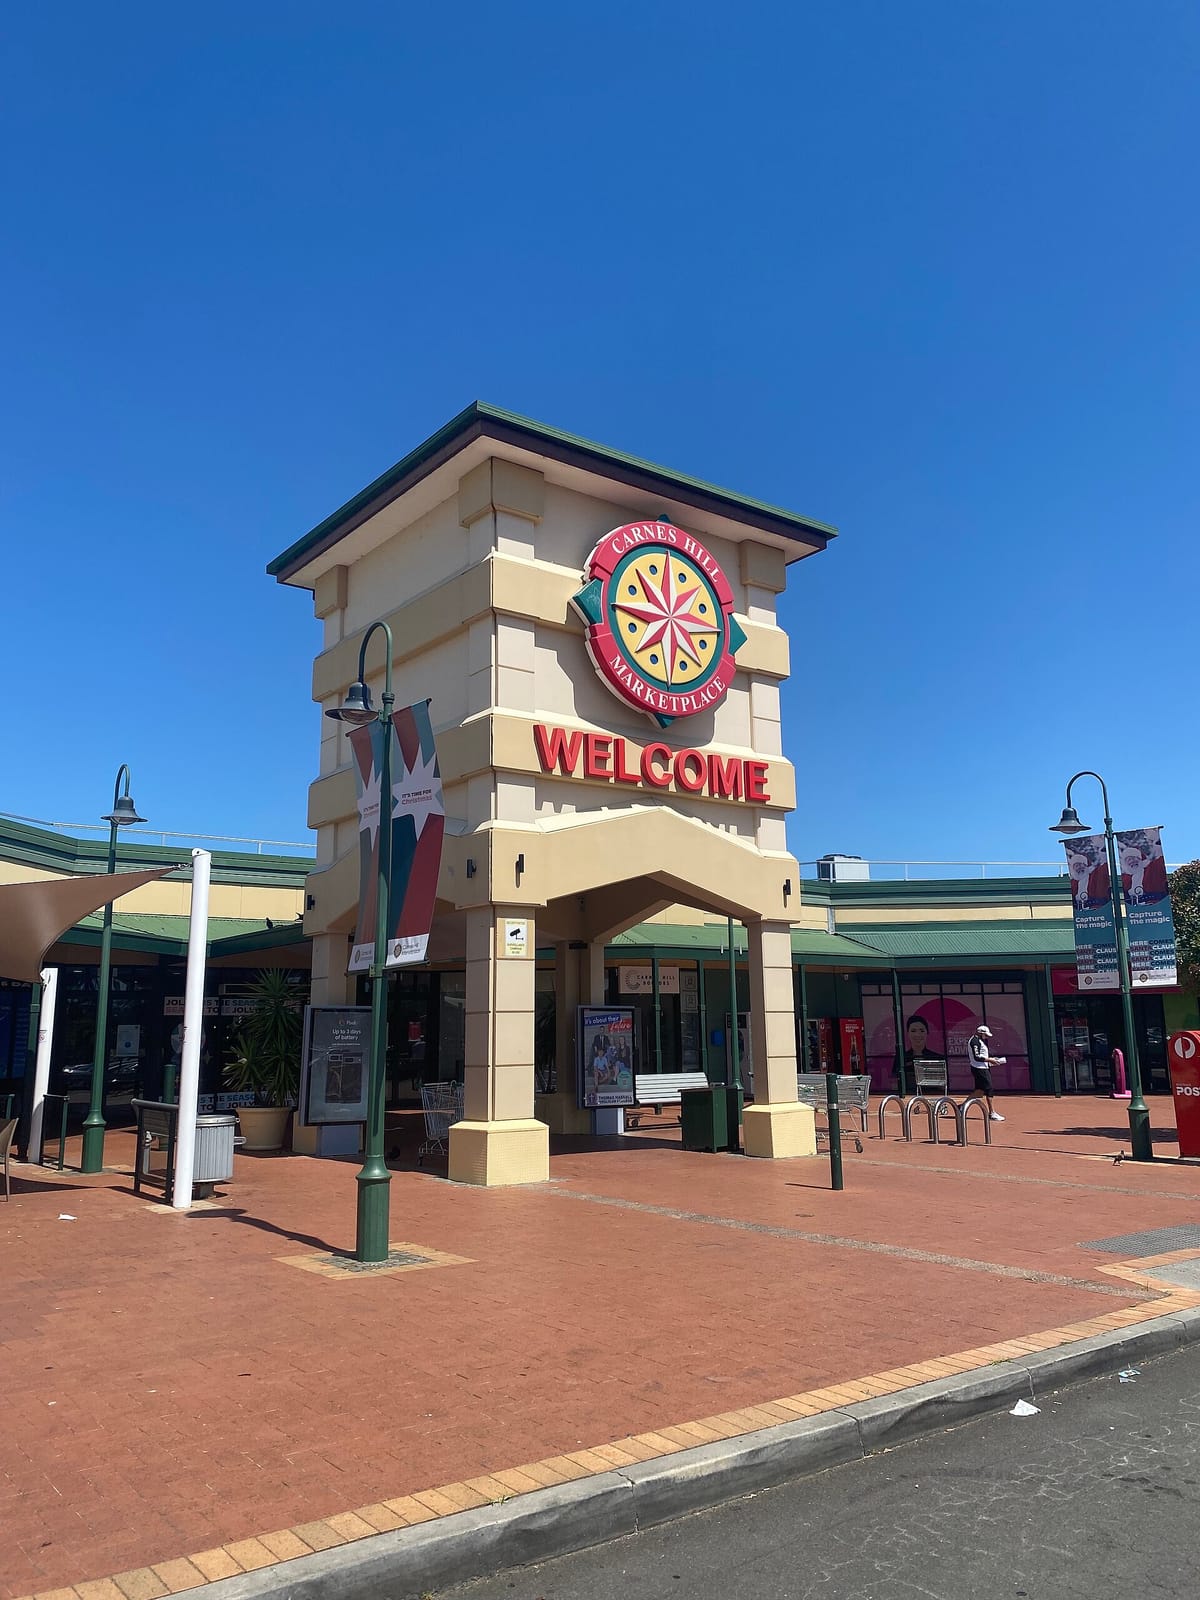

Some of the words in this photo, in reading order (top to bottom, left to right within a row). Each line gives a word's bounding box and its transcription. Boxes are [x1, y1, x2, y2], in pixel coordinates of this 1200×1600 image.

[611, 526, 678, 555] CARNES
[683, 537, 720, 583] HILL
[609, 655, 725, 712] MARKETPLACE
[533, 724, 771, 802] WELCOME
[1075, 915, 1105, 924] Capture
[1129, 911, 1162, 919] Capture
[1144, 916, 1170, 924] magic
[1089, 921, 1112, 929] magic
[1176, 1087, 1200, 1096] POS
